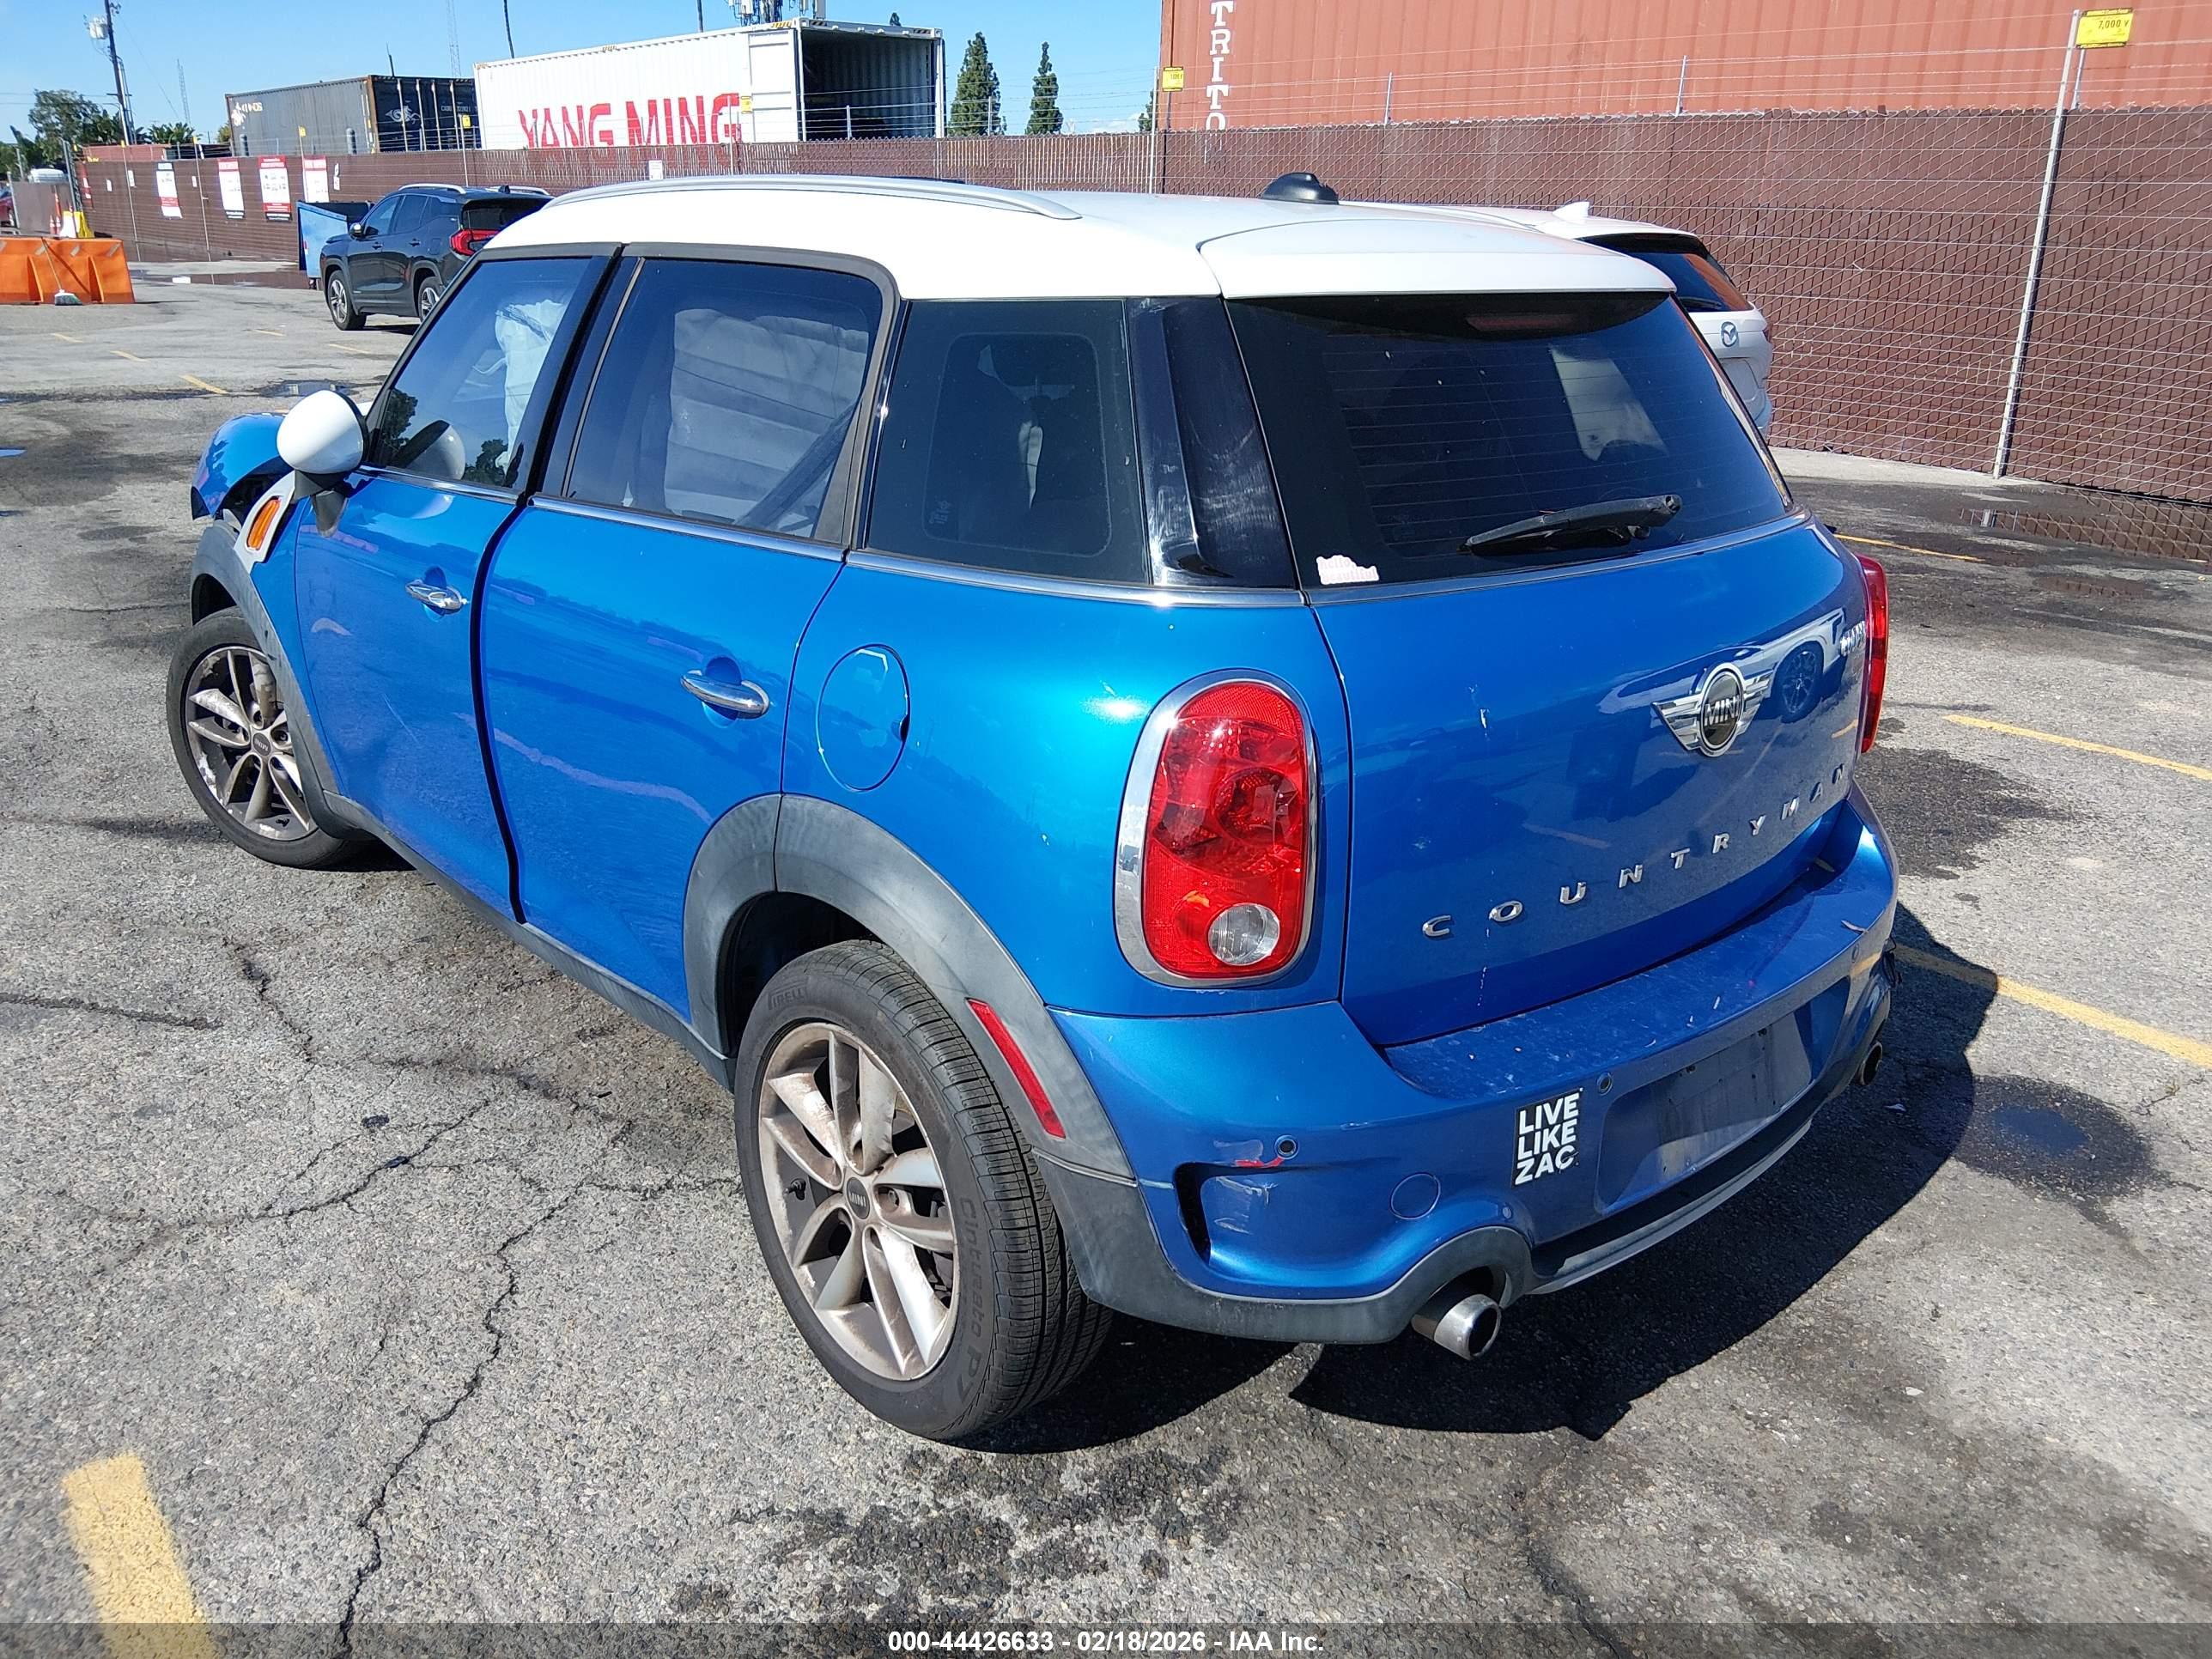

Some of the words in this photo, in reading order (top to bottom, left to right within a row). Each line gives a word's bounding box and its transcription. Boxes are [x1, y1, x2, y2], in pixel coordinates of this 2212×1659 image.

[2098, 19, 2121, 29] 7,000
[1204, 1, 1234, 163] TRITO
[518, 103, 614, 149] YANG
[625, 93, 742, 146] MING
[1704, 694, 1741, 727] MINI
[1422, 763, 1845, 938] COUNTRYMAN
[1519, 1092, 1580, 1135] LIVE
[1517, 1118, 1577, 1161] LIKE
[1515, 1145, 1576, 1185] ZAC
[848, 1191, 866, 1207] MINI
[958, 1197, 985, 1338] Cinturato
